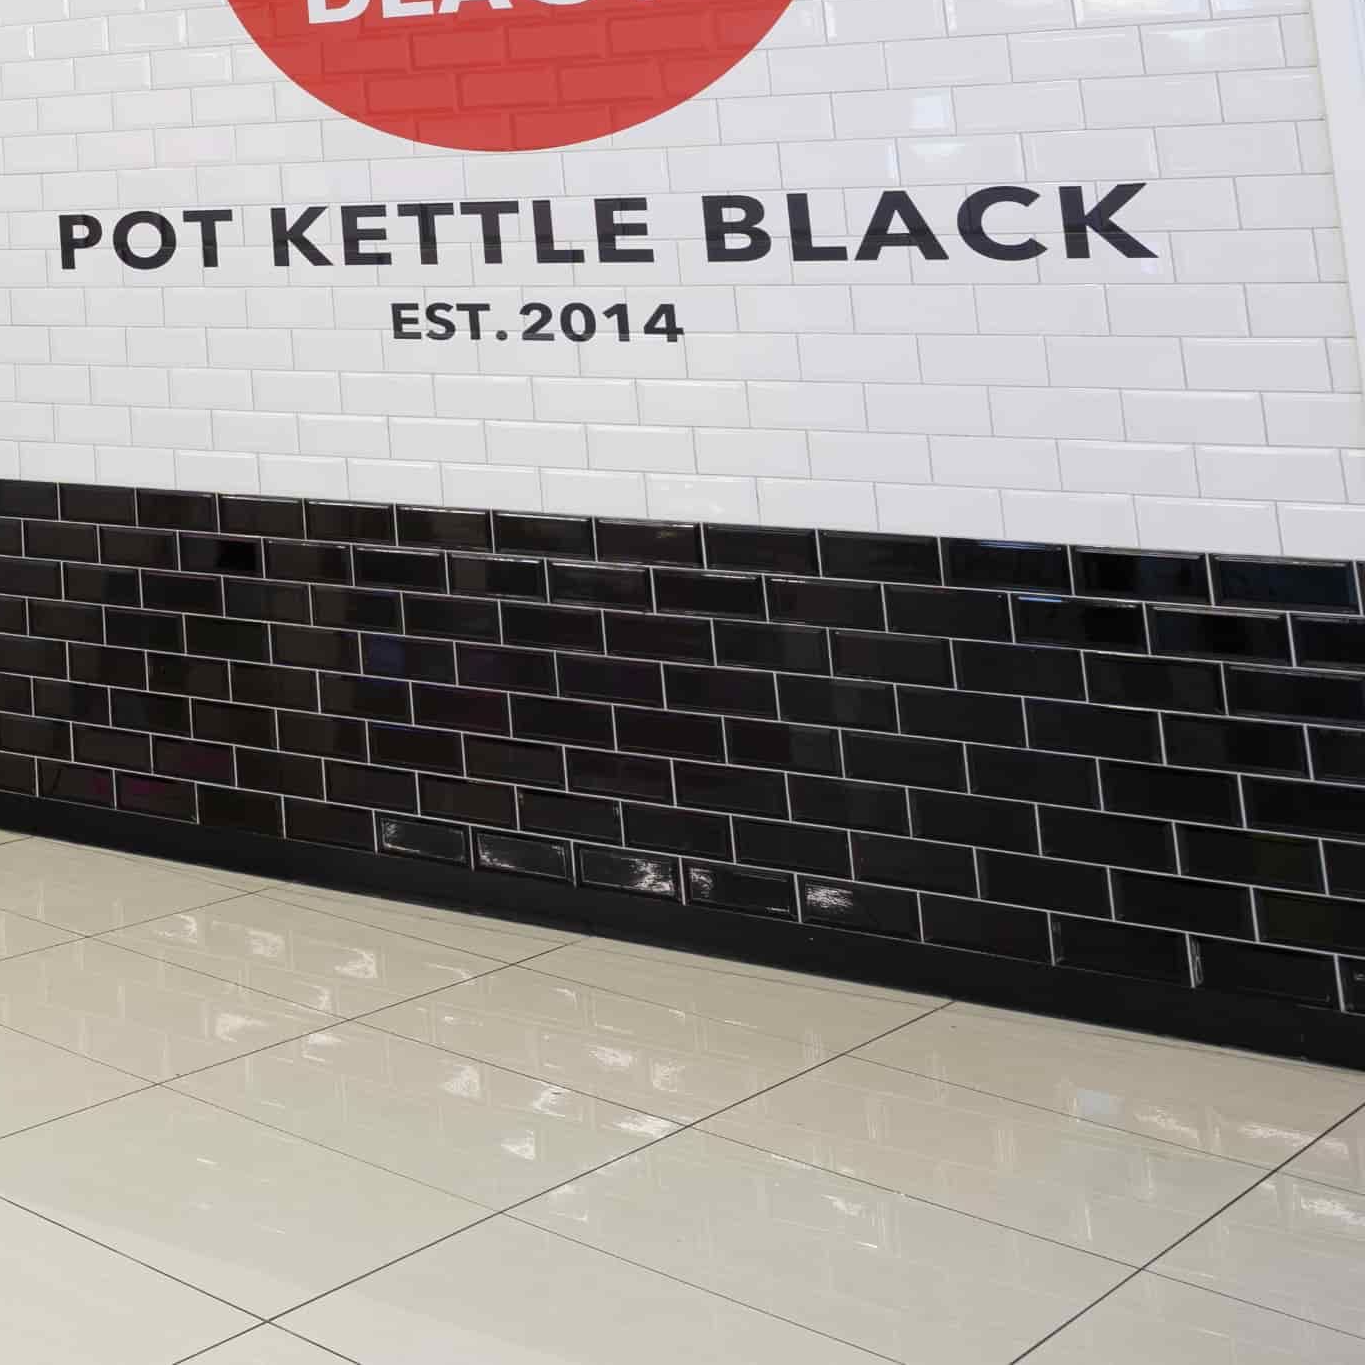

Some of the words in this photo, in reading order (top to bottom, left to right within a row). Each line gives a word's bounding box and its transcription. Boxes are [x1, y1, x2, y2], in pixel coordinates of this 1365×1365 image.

[57, 209, 234, 271] POT
[269, 197, 657, 268] KETTLE
[701, 182, 1159, 263] BLACK
